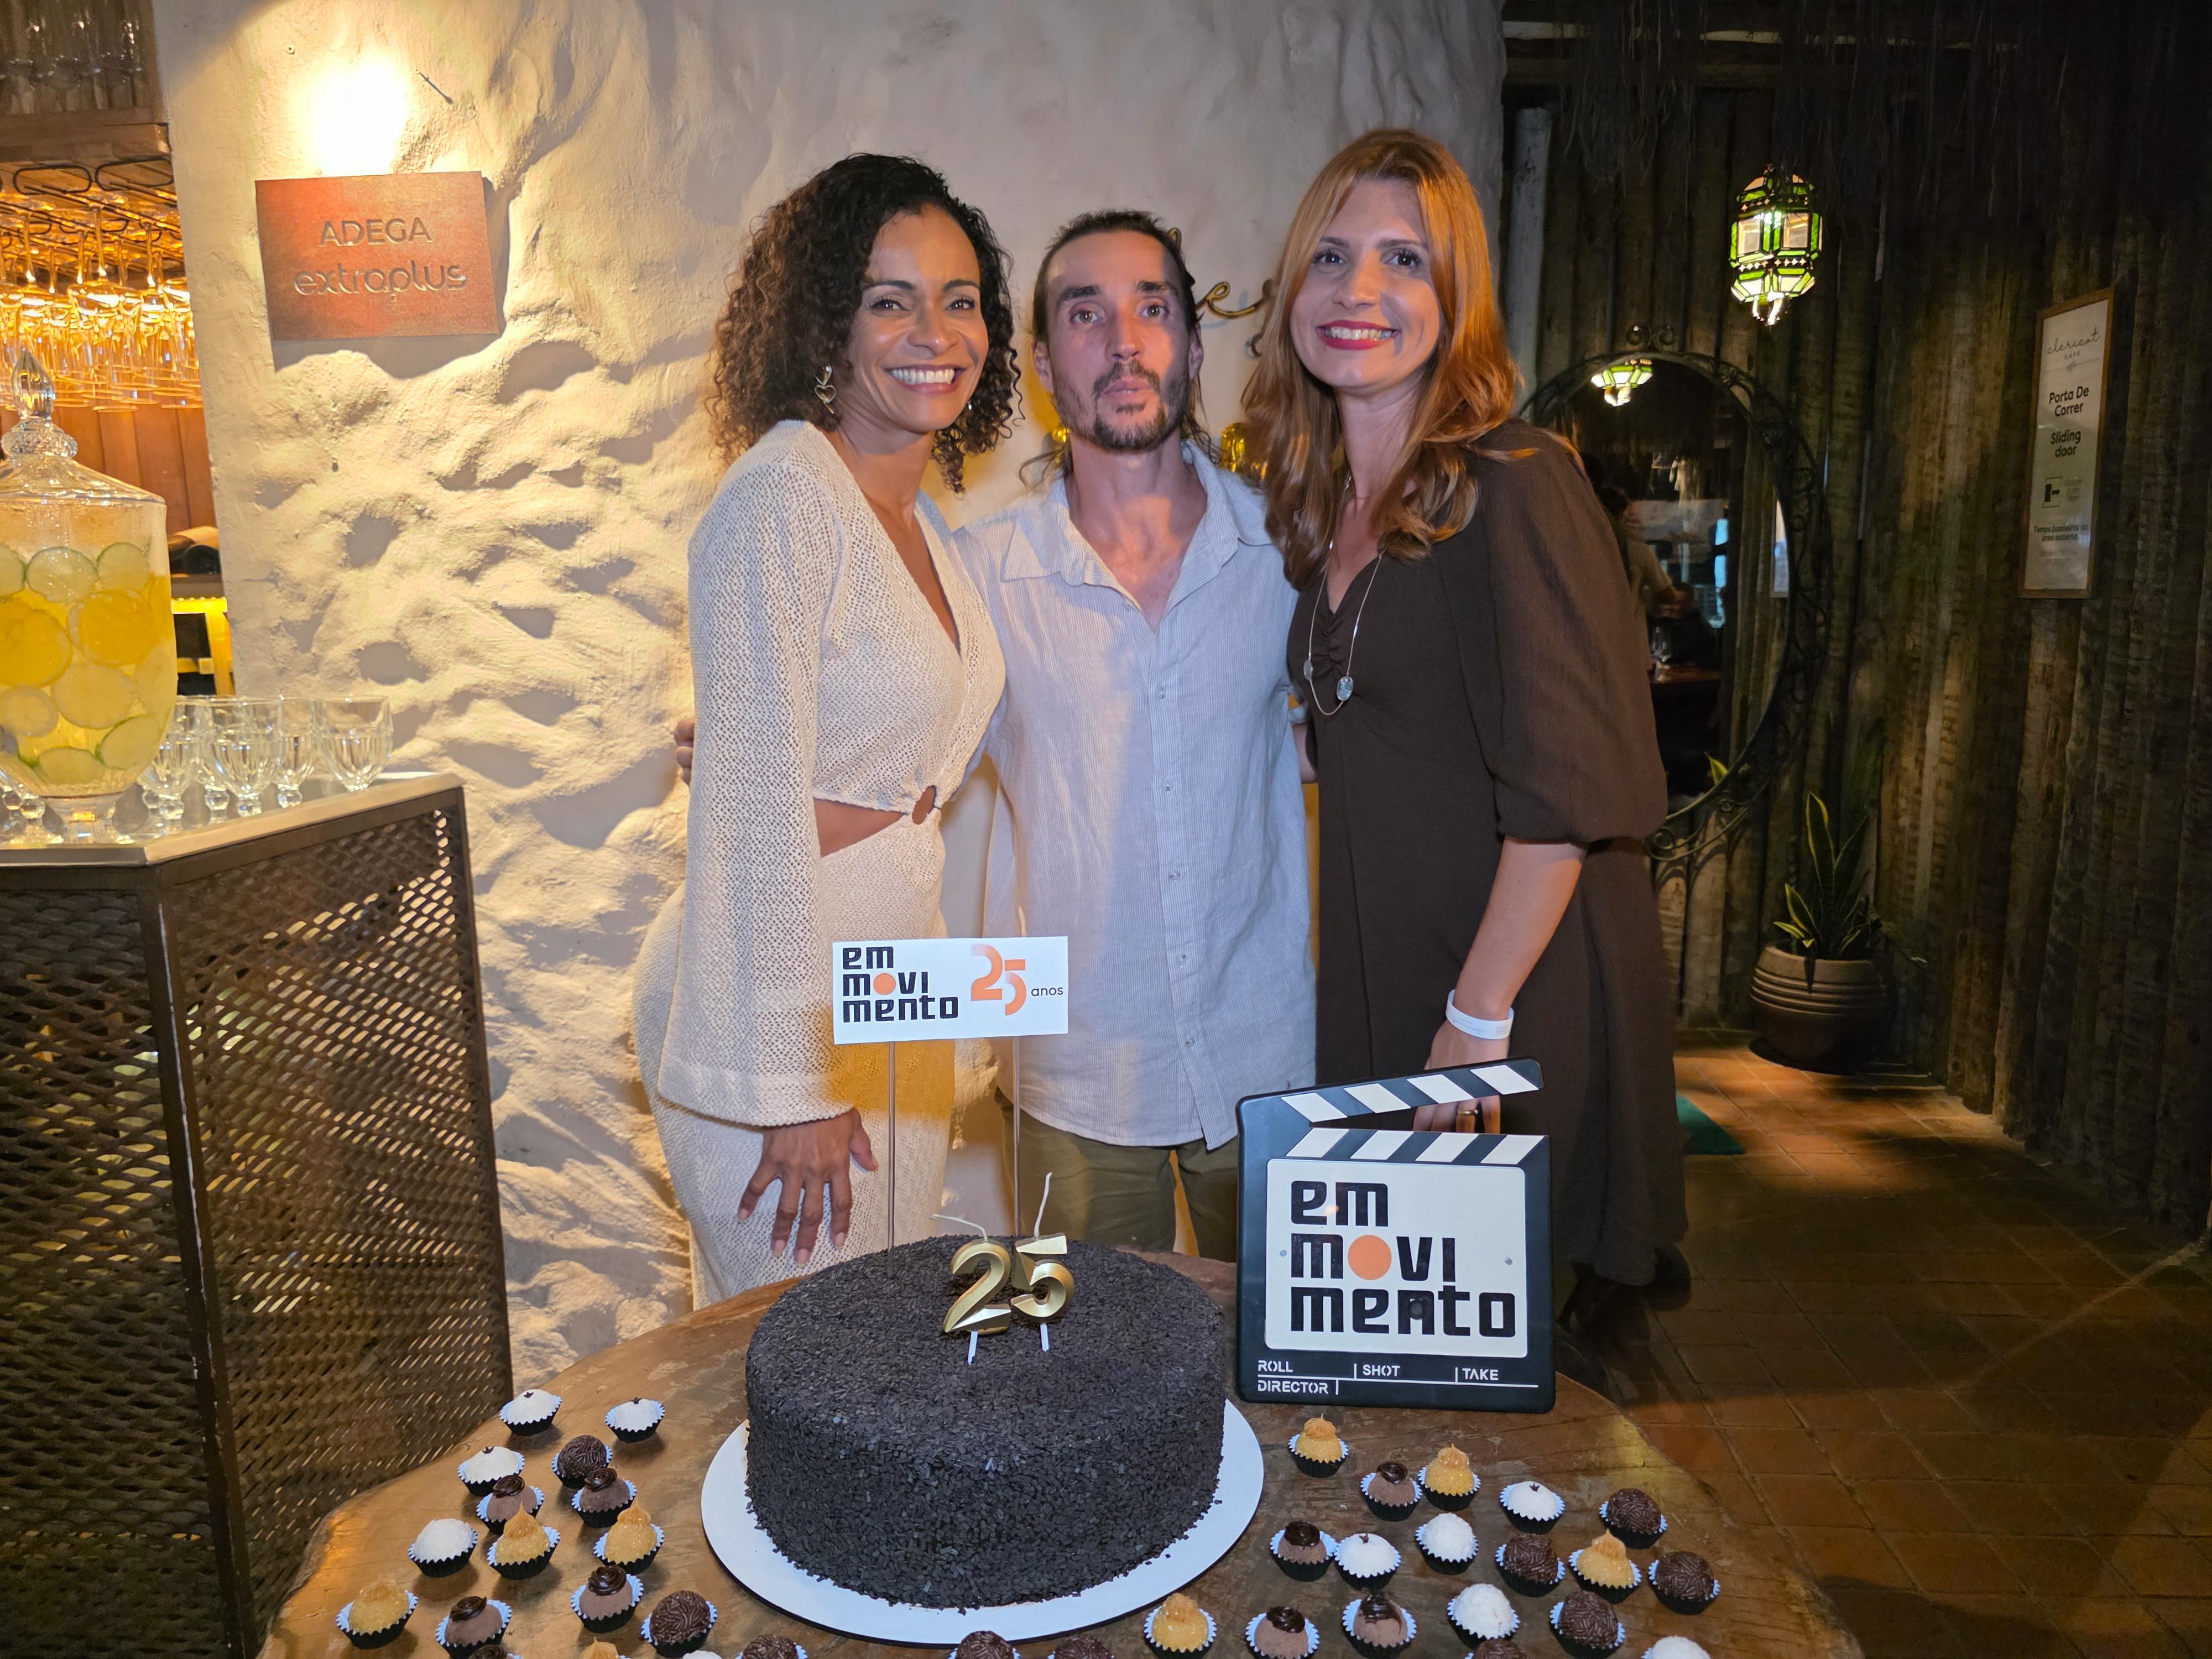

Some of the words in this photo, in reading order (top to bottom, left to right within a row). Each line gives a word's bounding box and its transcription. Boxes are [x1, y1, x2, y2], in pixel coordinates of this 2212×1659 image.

[319, 217, 434, 247] ADEGA
[293, 260, 467, 303] extraplus
[2049, 390, 2074, 404] Porta
[2076, 386, 2089, 399] De
[2054, 402, 2084, 417] Correr
[2051, 430, 2081, 445] Sliding
[2055, 446, 2077, 457] door
[842, 946, 894, 969] em
[971, 943, 1027, 1016] 25
[1031, 987, 1063, 997] anos
[843, 995, 958, 1023] mento
[1291, 1180, 1389, 1227] em
[1291, 1285, 1516, 1338] mento
[1258, 1360, 1293, 1373] ROLL
[1362, 1364, 1400, 1377] SHOT
[1462, 1368, 1499, 1381] TAKE
[1258, 1380, 1328, 1394] DIRECTOR
